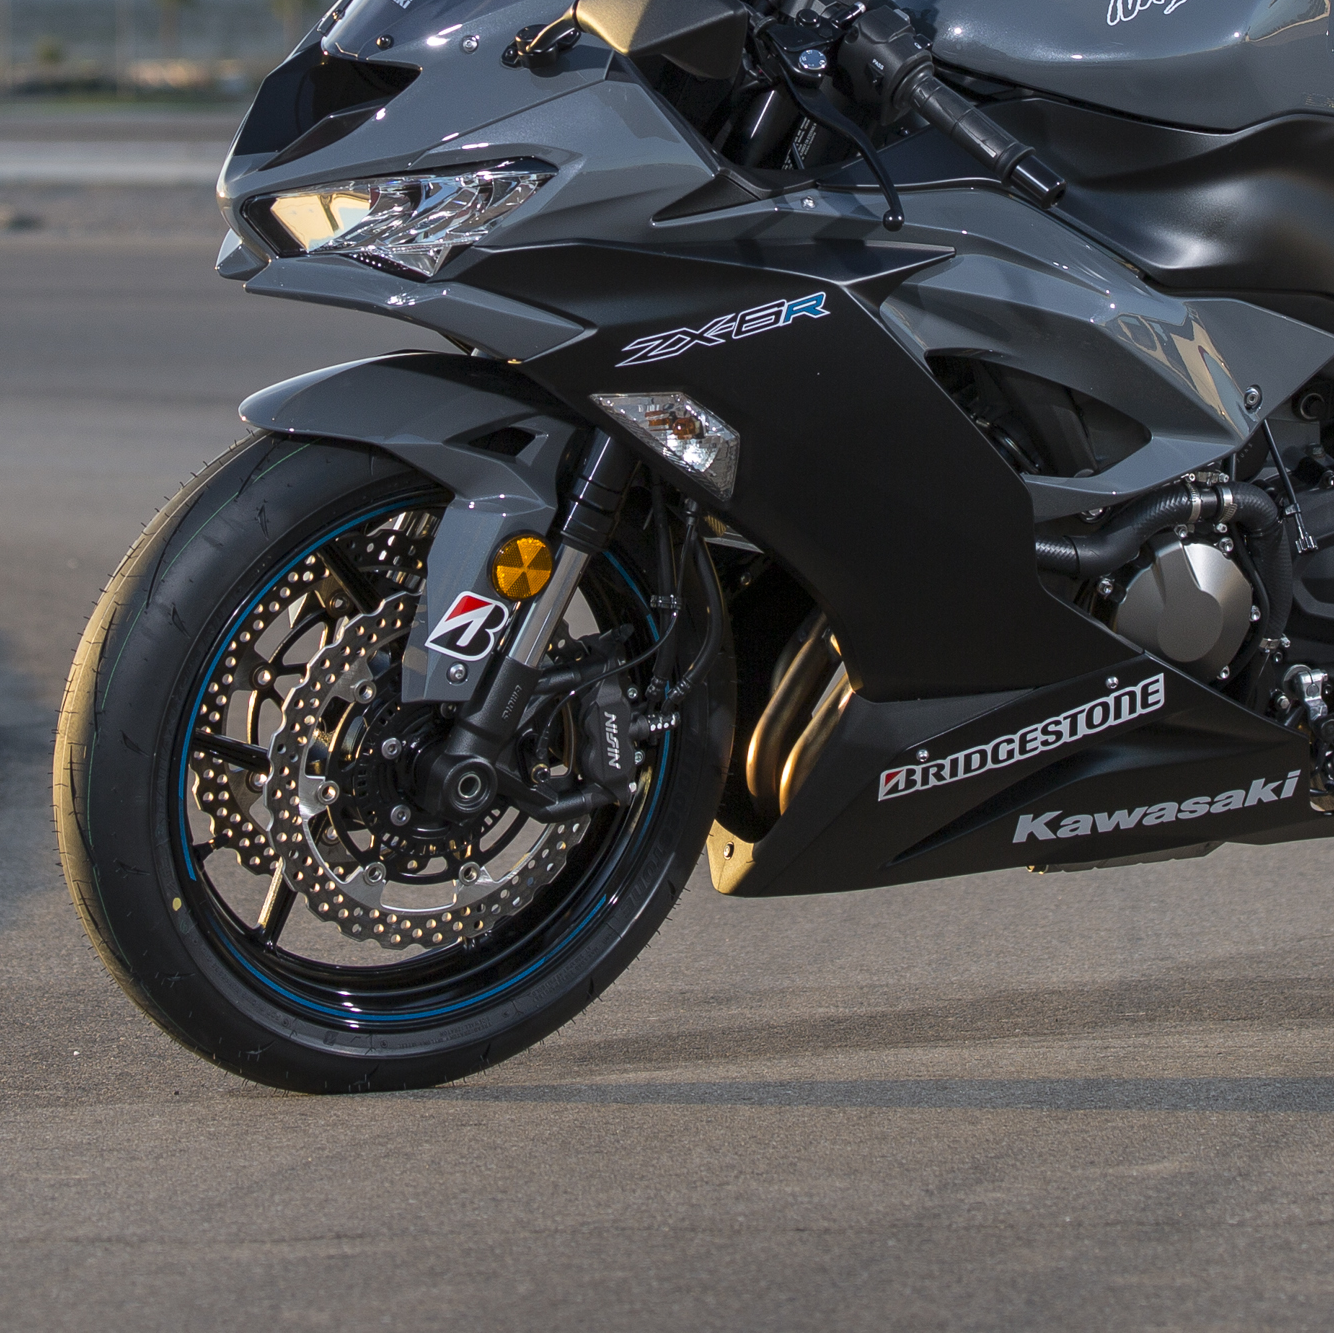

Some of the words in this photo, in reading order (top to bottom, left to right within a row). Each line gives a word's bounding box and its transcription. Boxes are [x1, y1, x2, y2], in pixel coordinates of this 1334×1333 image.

[615, 291, 831, 367] ZX-6R
[604, 710, 621, 770] NISSIN
[878, 672, 1165, 802] BRIDGESTONE
[1012, 769, 1302, 844] Kawasaki
